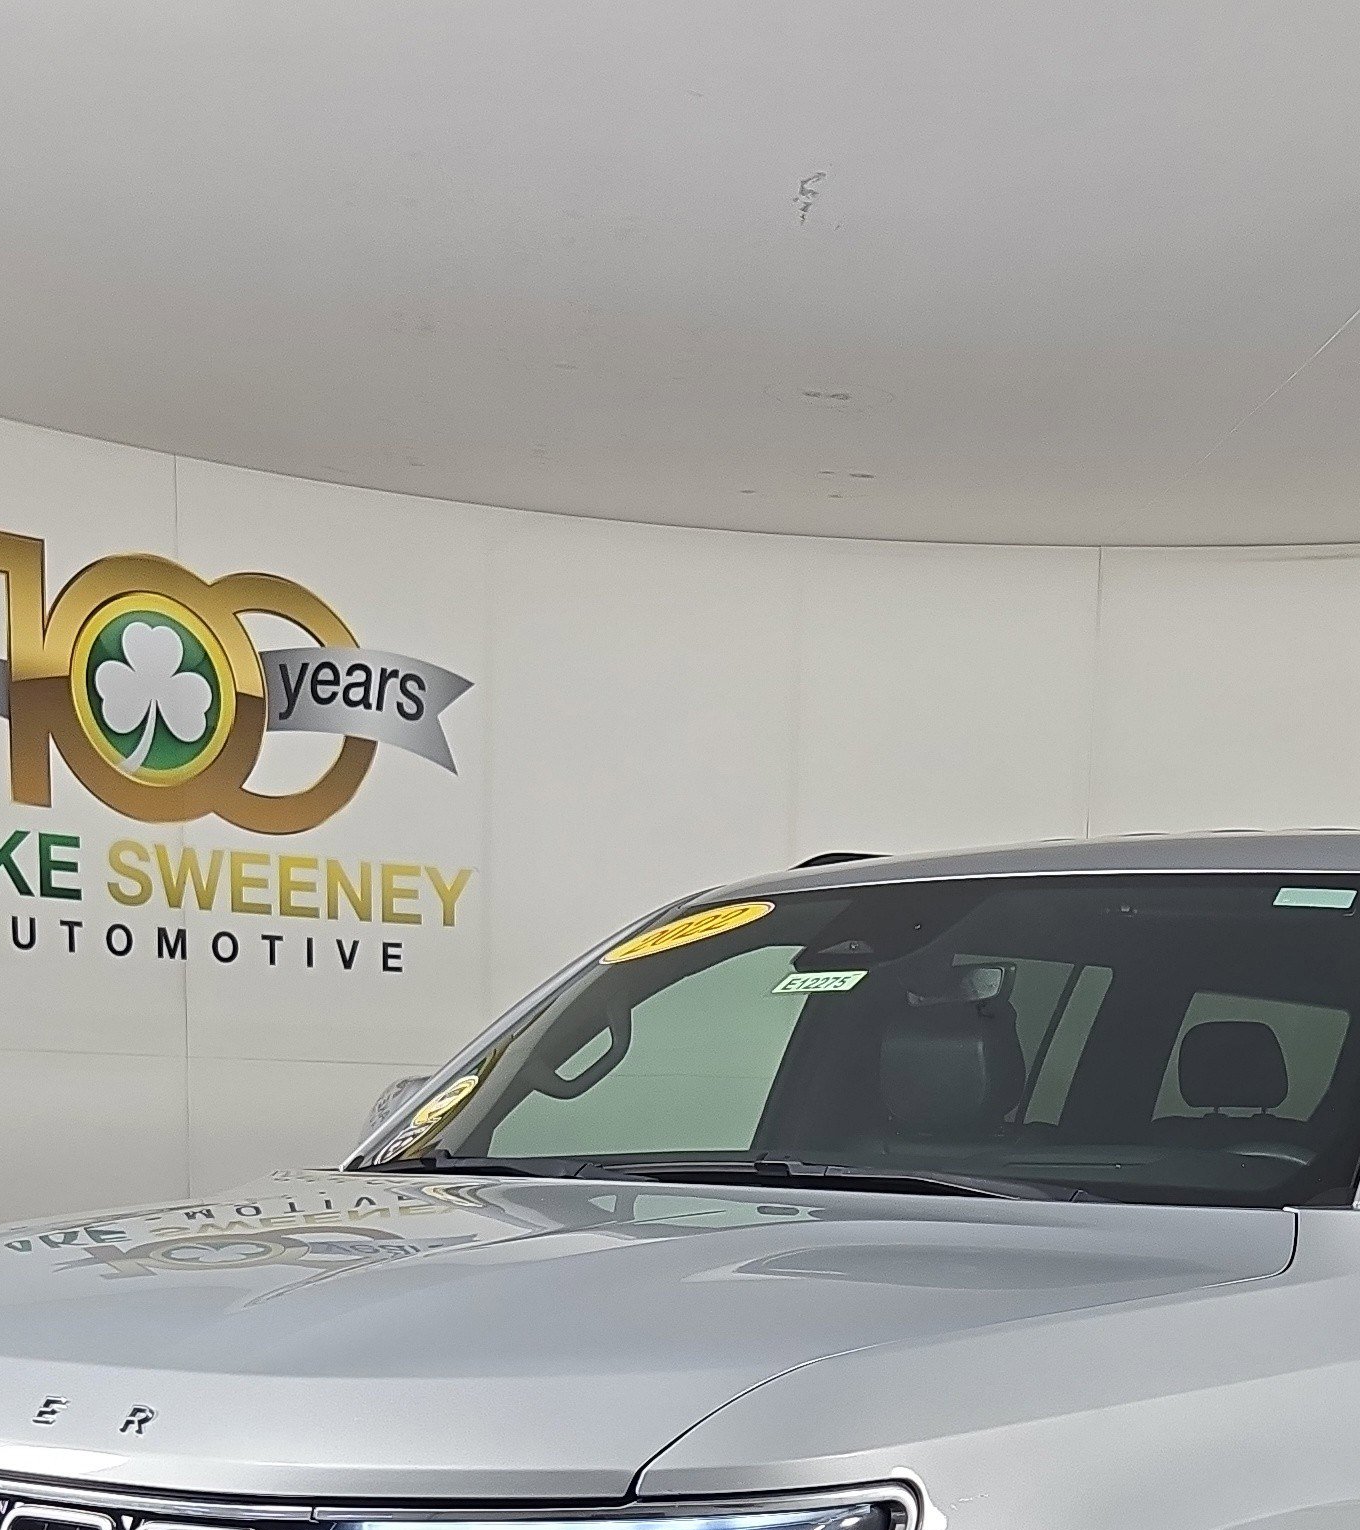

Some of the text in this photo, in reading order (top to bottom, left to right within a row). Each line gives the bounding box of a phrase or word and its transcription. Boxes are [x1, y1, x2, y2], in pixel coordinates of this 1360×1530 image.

[277, 660, 427, 721] years
[107, 839, 473, 927] SWEENEY
[619, 907, 751, 958] 2022
[781, 975, 852, 990] E12275
